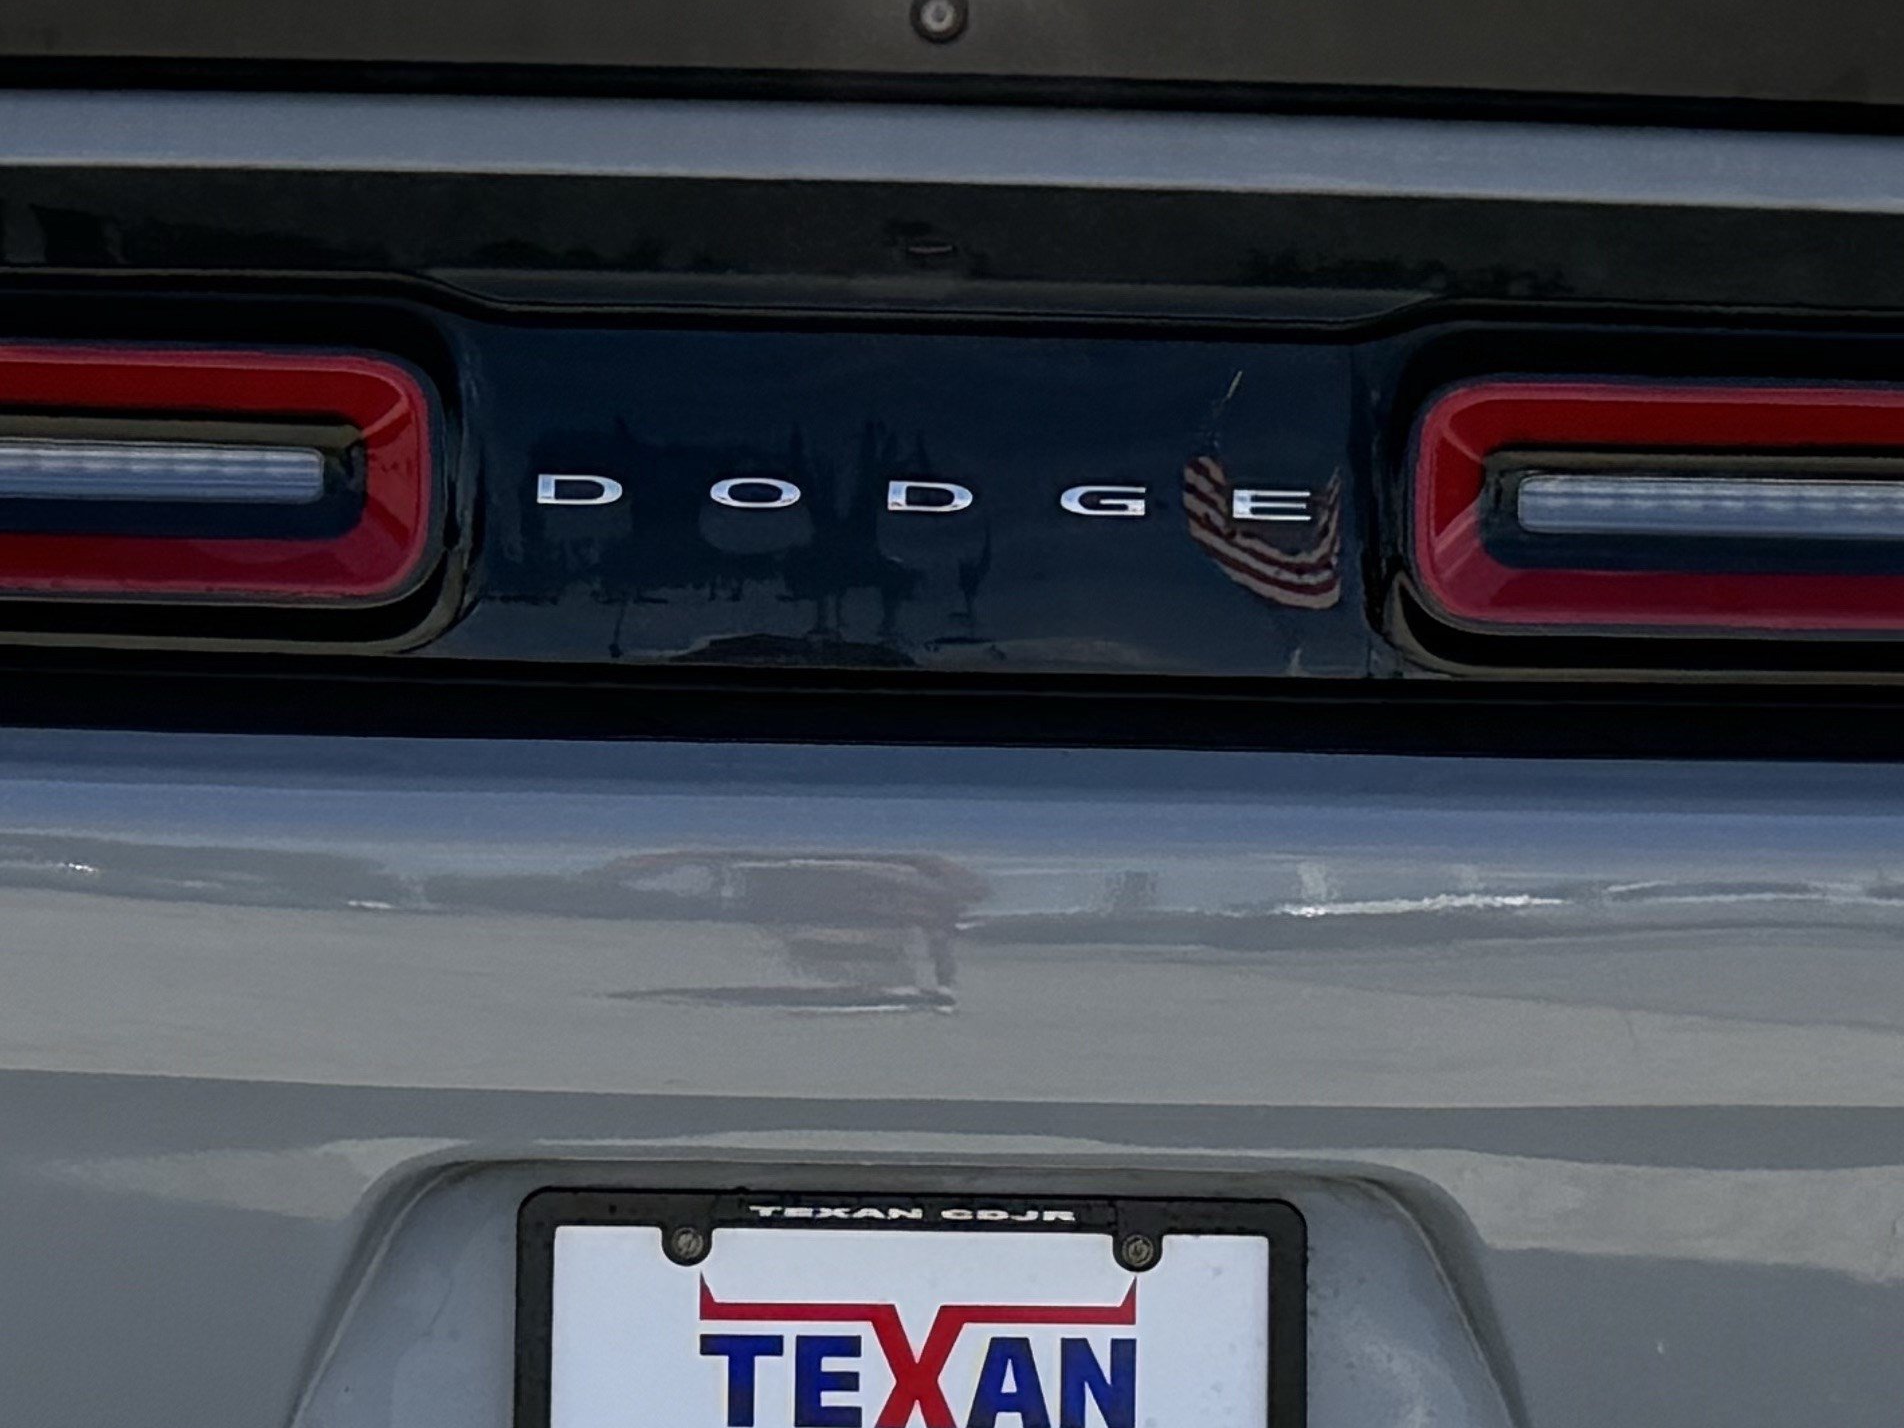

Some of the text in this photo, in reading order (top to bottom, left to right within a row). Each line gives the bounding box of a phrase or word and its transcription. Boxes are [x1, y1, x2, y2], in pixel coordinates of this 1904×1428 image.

[535, 473, 1312, 523] DODGE
[749, 1205, 1077, 1223] TEXAN CDJR
